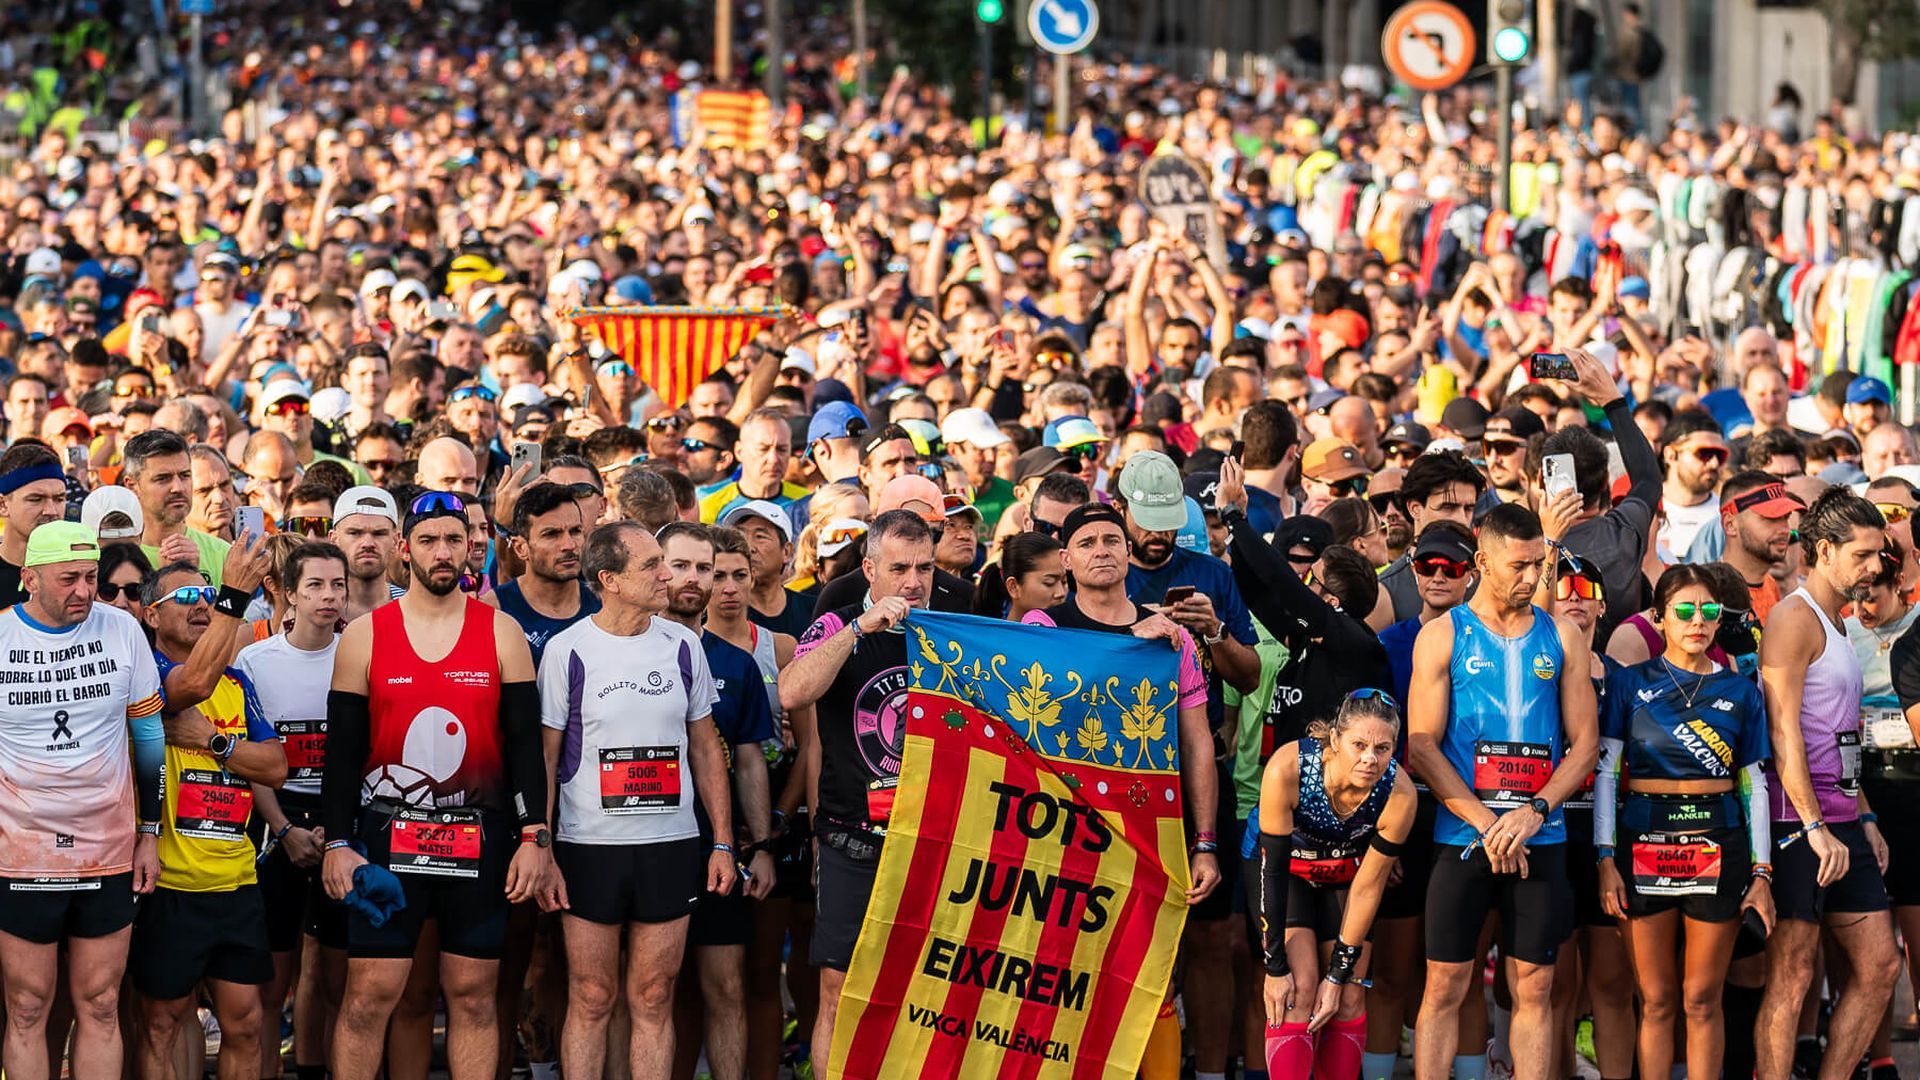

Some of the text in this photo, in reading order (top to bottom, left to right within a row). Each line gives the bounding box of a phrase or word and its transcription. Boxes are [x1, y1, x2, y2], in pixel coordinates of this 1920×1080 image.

[9, 649, 30, 664] QUE
[33, 650, 46, 665] EL
[87, 640, 103, 655] NO
[38, 670, 51, 683] LO
[55, 666, 77, 682] QUE
[80, 662, 96, 678] UN
[98, 657, 118, 675] DÍA
[388, 676, 413, 685] mobel
[873, 673, 905, 696] TT'S
[8, 682, 111, 706] CUBRIÓ EL BARRO
[597, 681, 637, 699] ROLLITO
[1711, 698, 1734, 711] NB
[628, 765, 657, 779] 5005
[879, 755, 903, 774] RUN
[1498, 761, 1535, 776] 20140
[623, 781, 662, 793] MARINO
[1500, 777, 1532, 789] Guerra
[202, 790, 236, 805] 29462
[989, 781, 1113, 853] TOTS
[1668, 811, 1711, 820] HANKER
[415, 827, 455, 841] 26273
[417, 844, 453, 855] MATEU
[1656, 849, 1696, 861] 26467
[1656, 864, 1697, 874] MIRIAM
[948, 858, 1116, 933] JUNTS
[922, 937, 1091, 1011] EIXIREM
[909, 1003, 1070, 1063] VIXCA VALÈNCIA
